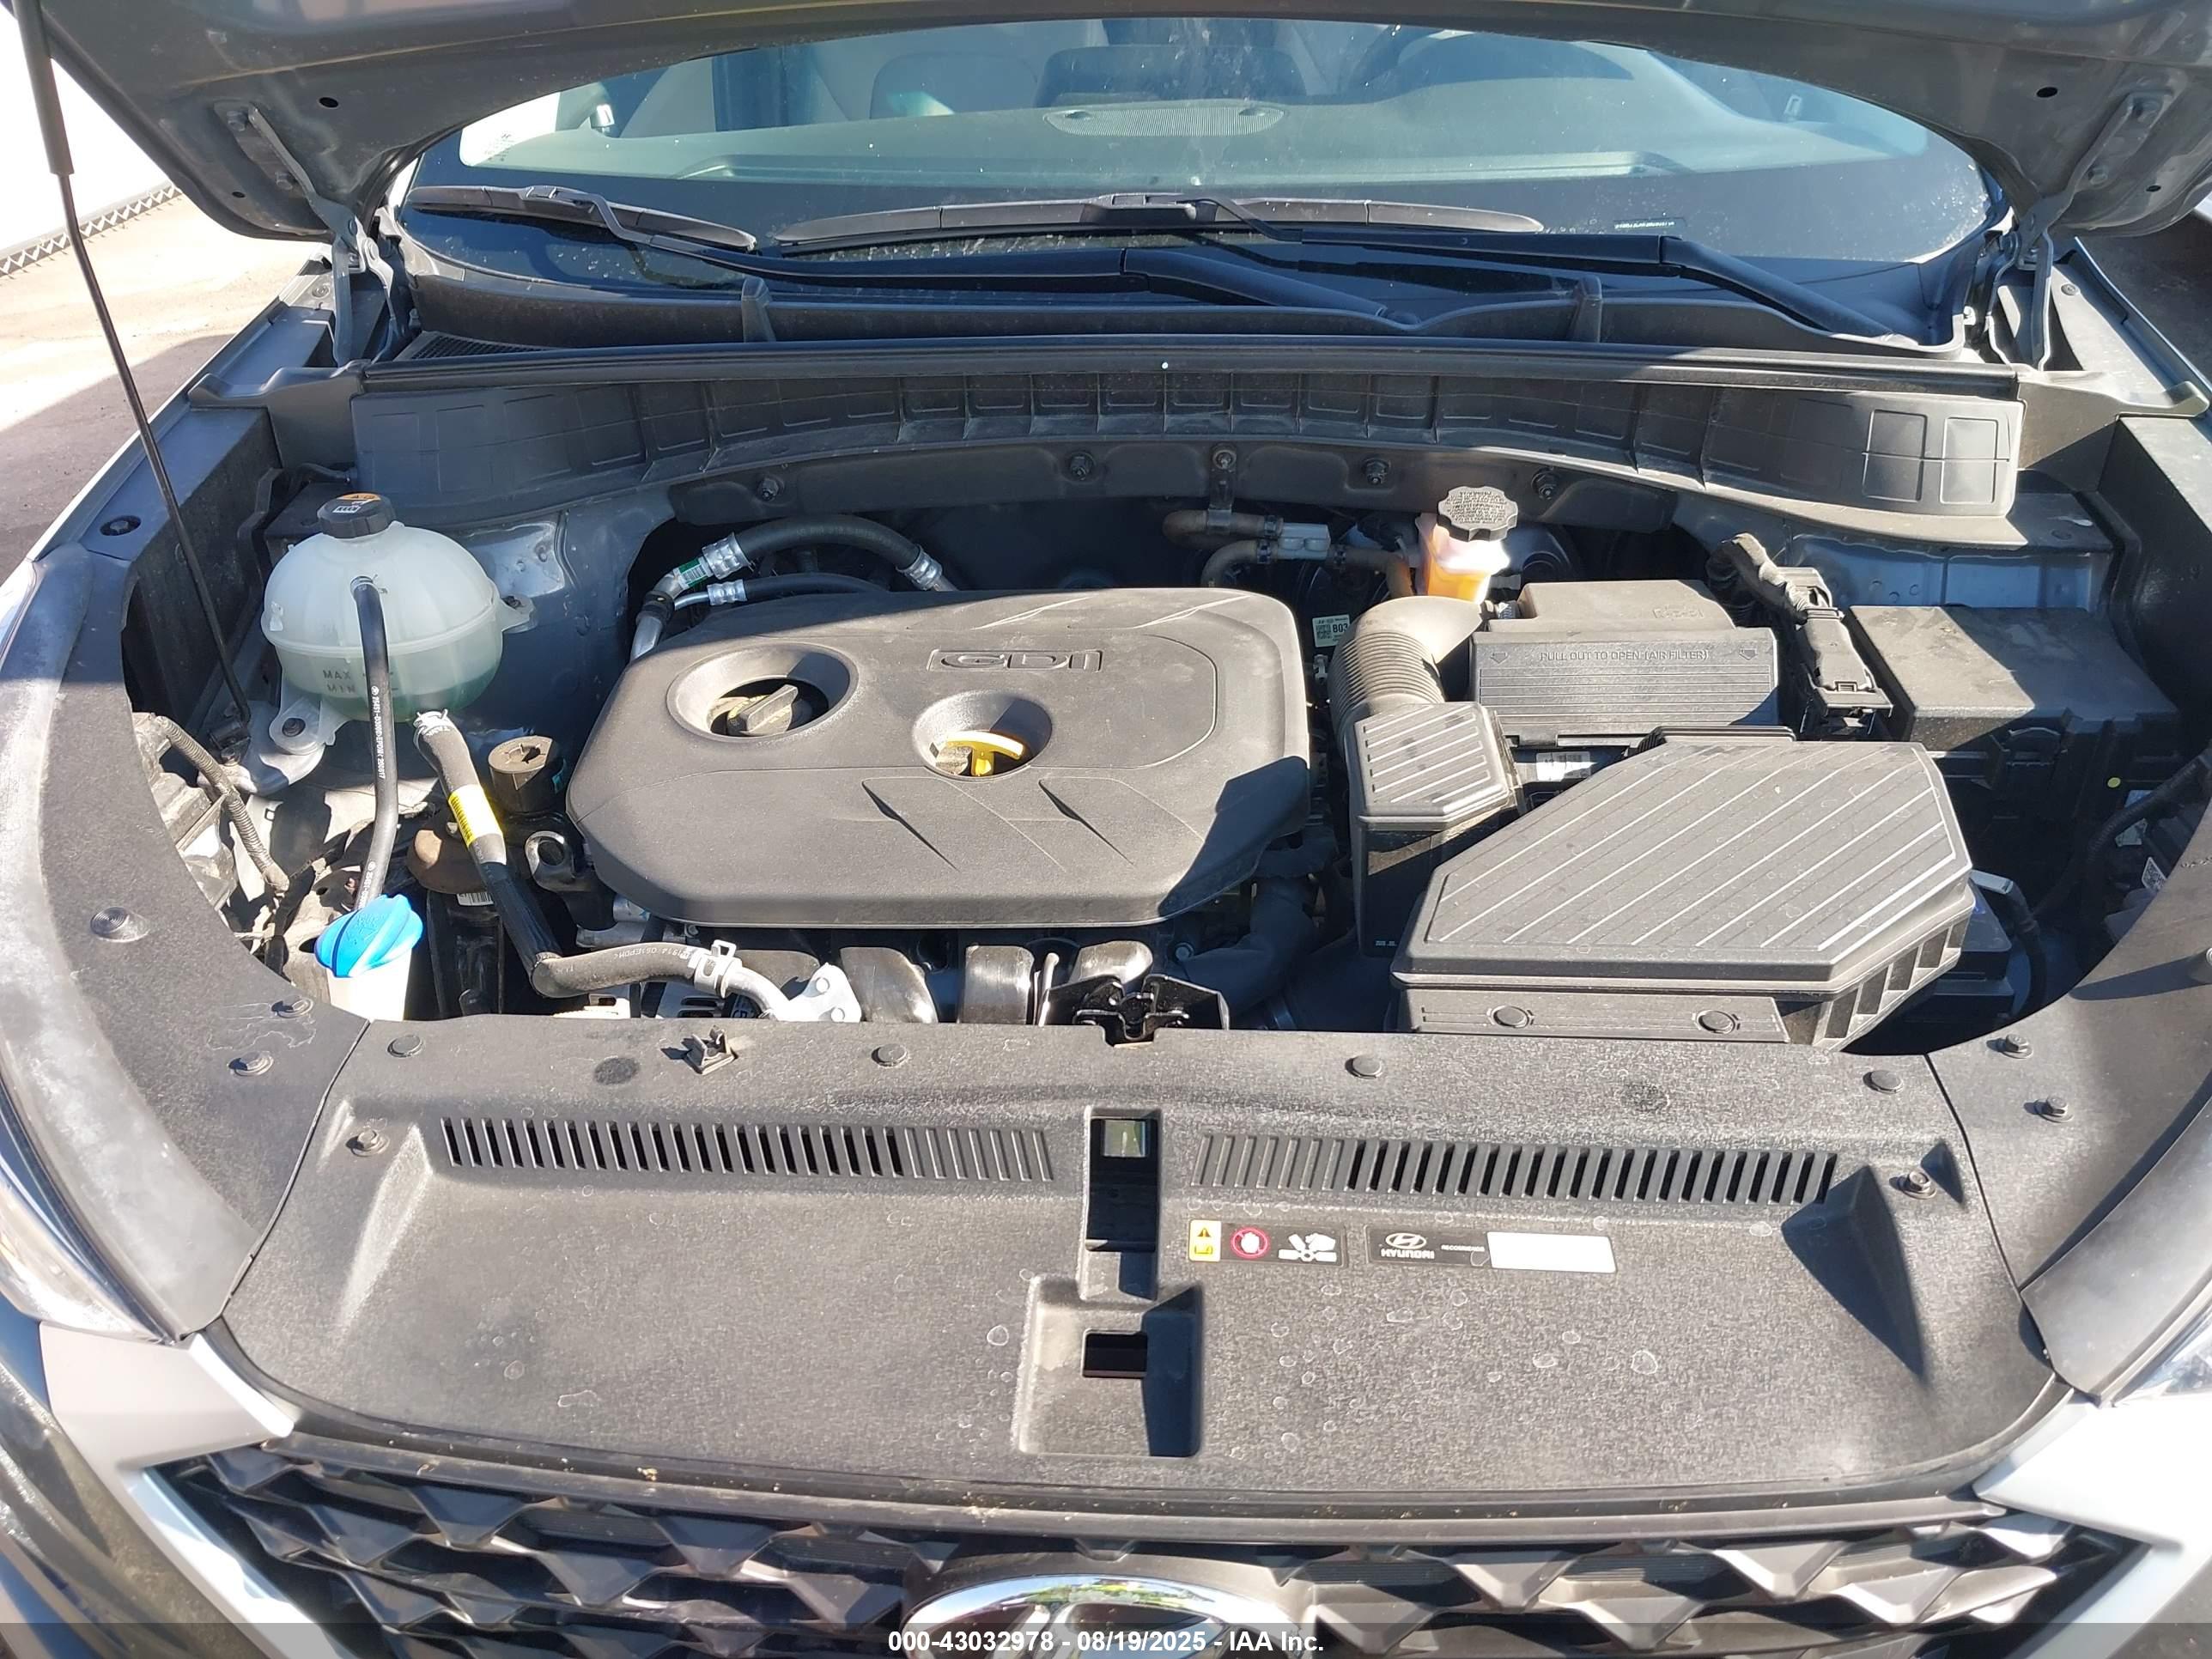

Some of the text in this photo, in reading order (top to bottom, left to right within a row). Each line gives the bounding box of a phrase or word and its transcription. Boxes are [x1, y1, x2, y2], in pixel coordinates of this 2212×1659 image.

[1540, 652, 1568, 661] PULL
[1570, 652, 1591, 660] OUT
[1595, 652, 1608, 660] TO
[1611, 651, 1640, 660] OPEN
[940, 653, 1087, 670] GDI
[323, 670, 351, 679] MAX
[327, 684, 356, 693] MIN
[1381, 1249, 1435, 1260] HYUNDAI
